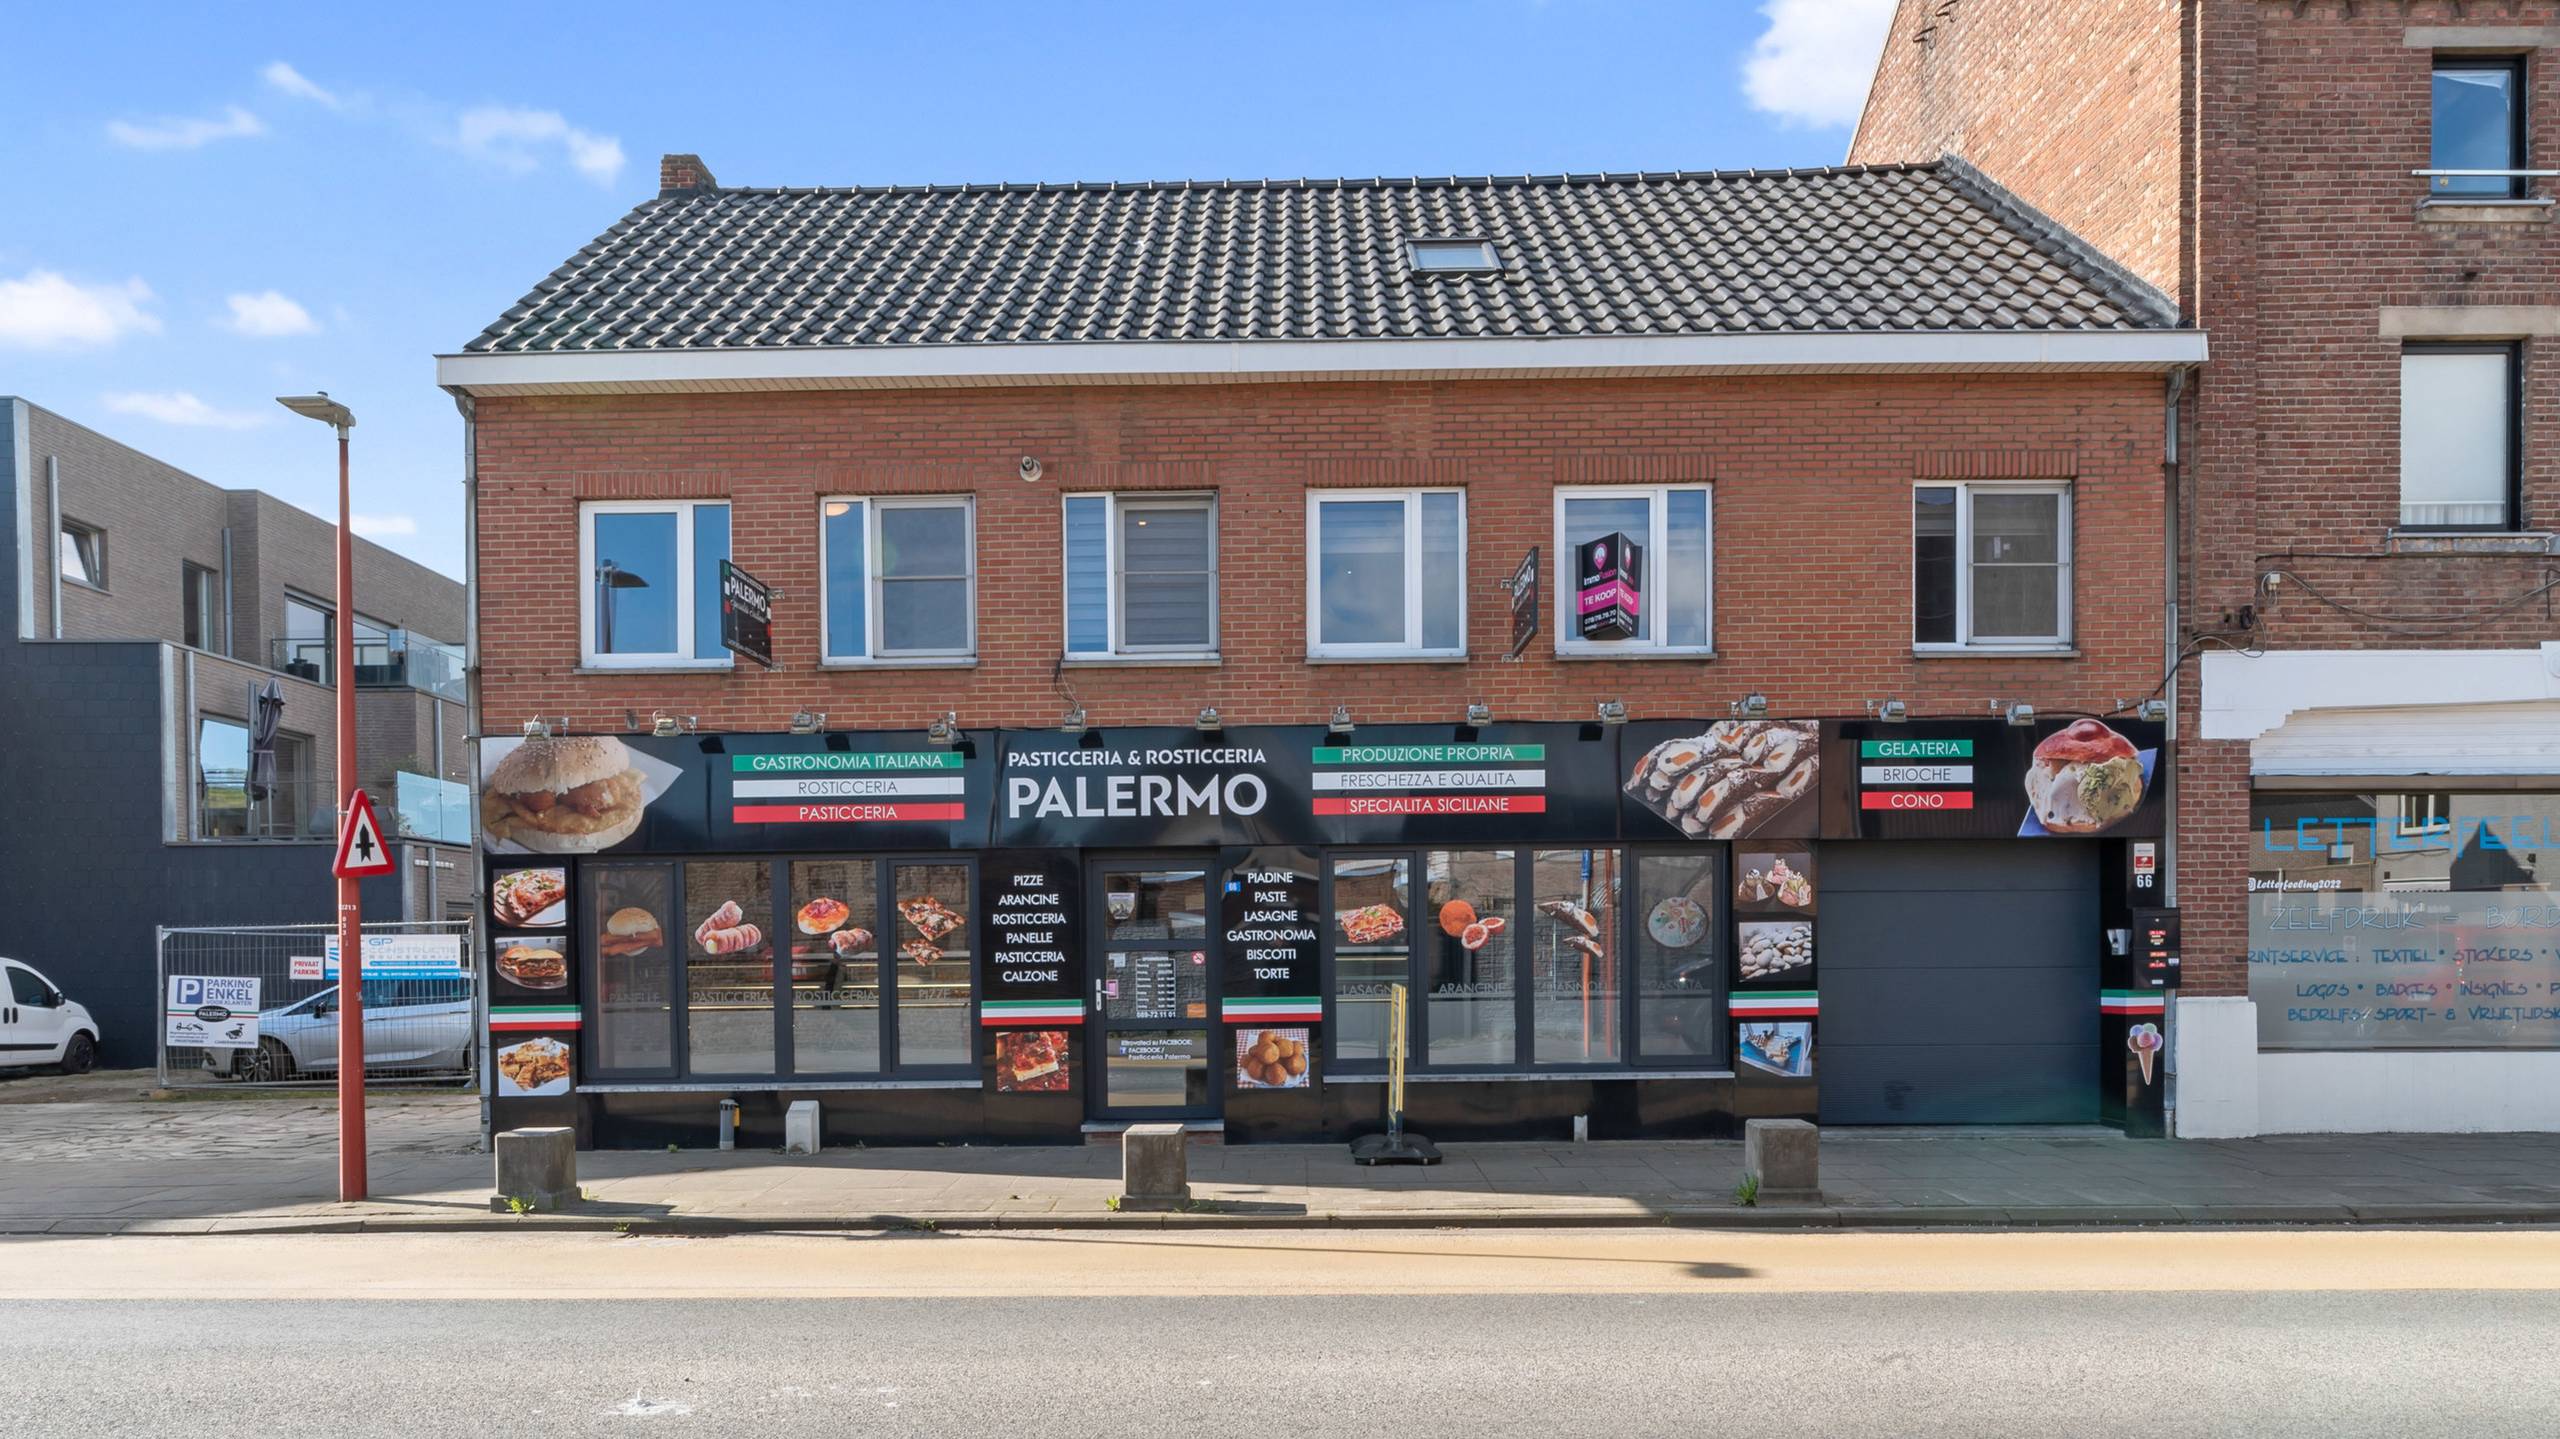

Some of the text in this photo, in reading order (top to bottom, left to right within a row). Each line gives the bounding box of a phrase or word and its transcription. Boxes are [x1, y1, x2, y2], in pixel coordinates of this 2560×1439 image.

[730, 577, 766, 612] PALERMO
[1584, 596, 1594, 606] TE
[1595, 588, 1617, 603] KOOP
[1342, 746, 1514, 762] PRODUZIONE PROPRIA
[1879, 742, 1960, 756] GELATERIA
[752, 754, 944, 770] GASTRONOMIA ITALIANA
[1008, 748, 1267, 767] PASTICCERIA & ROSTICCERIA
[1340, 773, 1432, 787] FRESCHEZZA
[1438, 773, 1446, 786] E
[1882, 767, 1952, 782] BRIOCHE
[798, 781, 898, 795] ROSTICCERIA
[1008, 773, 1267, 818] PALERMO
[1890, 794, 1943, 809] CONO
[1349, 798, 1509, 813] SPECIALITA SICILIANE
[799, 805, 898, 820] PASTICCERIA
[1014, 875, 1043, 886] PIZZE
[1248, 872, 1293, 884] PIADINE
[2136, 874, 2153, 888] 66
[998, 893, 1059, 906] ARANCINE
[1254, 891, 1287, 903] PASTE
[992, 913, 1067, 925] ROSTICCERIA
[1244, 910, 1298, 922] LASAGNE
[2269, 902, 2425, 936] ZEEFDRUK
[1006, 932, 1053, 944] PANELLE
[1226, 929, 1316, 941] GASTRONOMIA
[368, 938, 393, 947] GP
[995, 952, 1066, 963] PASTICCERIA
[1246, 949, 1297, 960] BISCOTTI
[2372, 948, 2436, 964] TEXTIEL
[2452, 946, 2534, 964] STICKERS
[1002, 970, 1059, 982] CALZONE
[1254, 968, 1290, 979] TORTE
[207, 978, 253, 988] PARKING
[1439, 982, 1507, 994] ARANCINE
[206, 988, 253, 1000] ENKEL
[692, 991, 769, 1002] PASTICCERIA
[2296, 983, 2350, 1000] LOGOS
[2375, 983, 2438, 997] BADGES
[2459, 980, 2528, 998] INSIGNES
